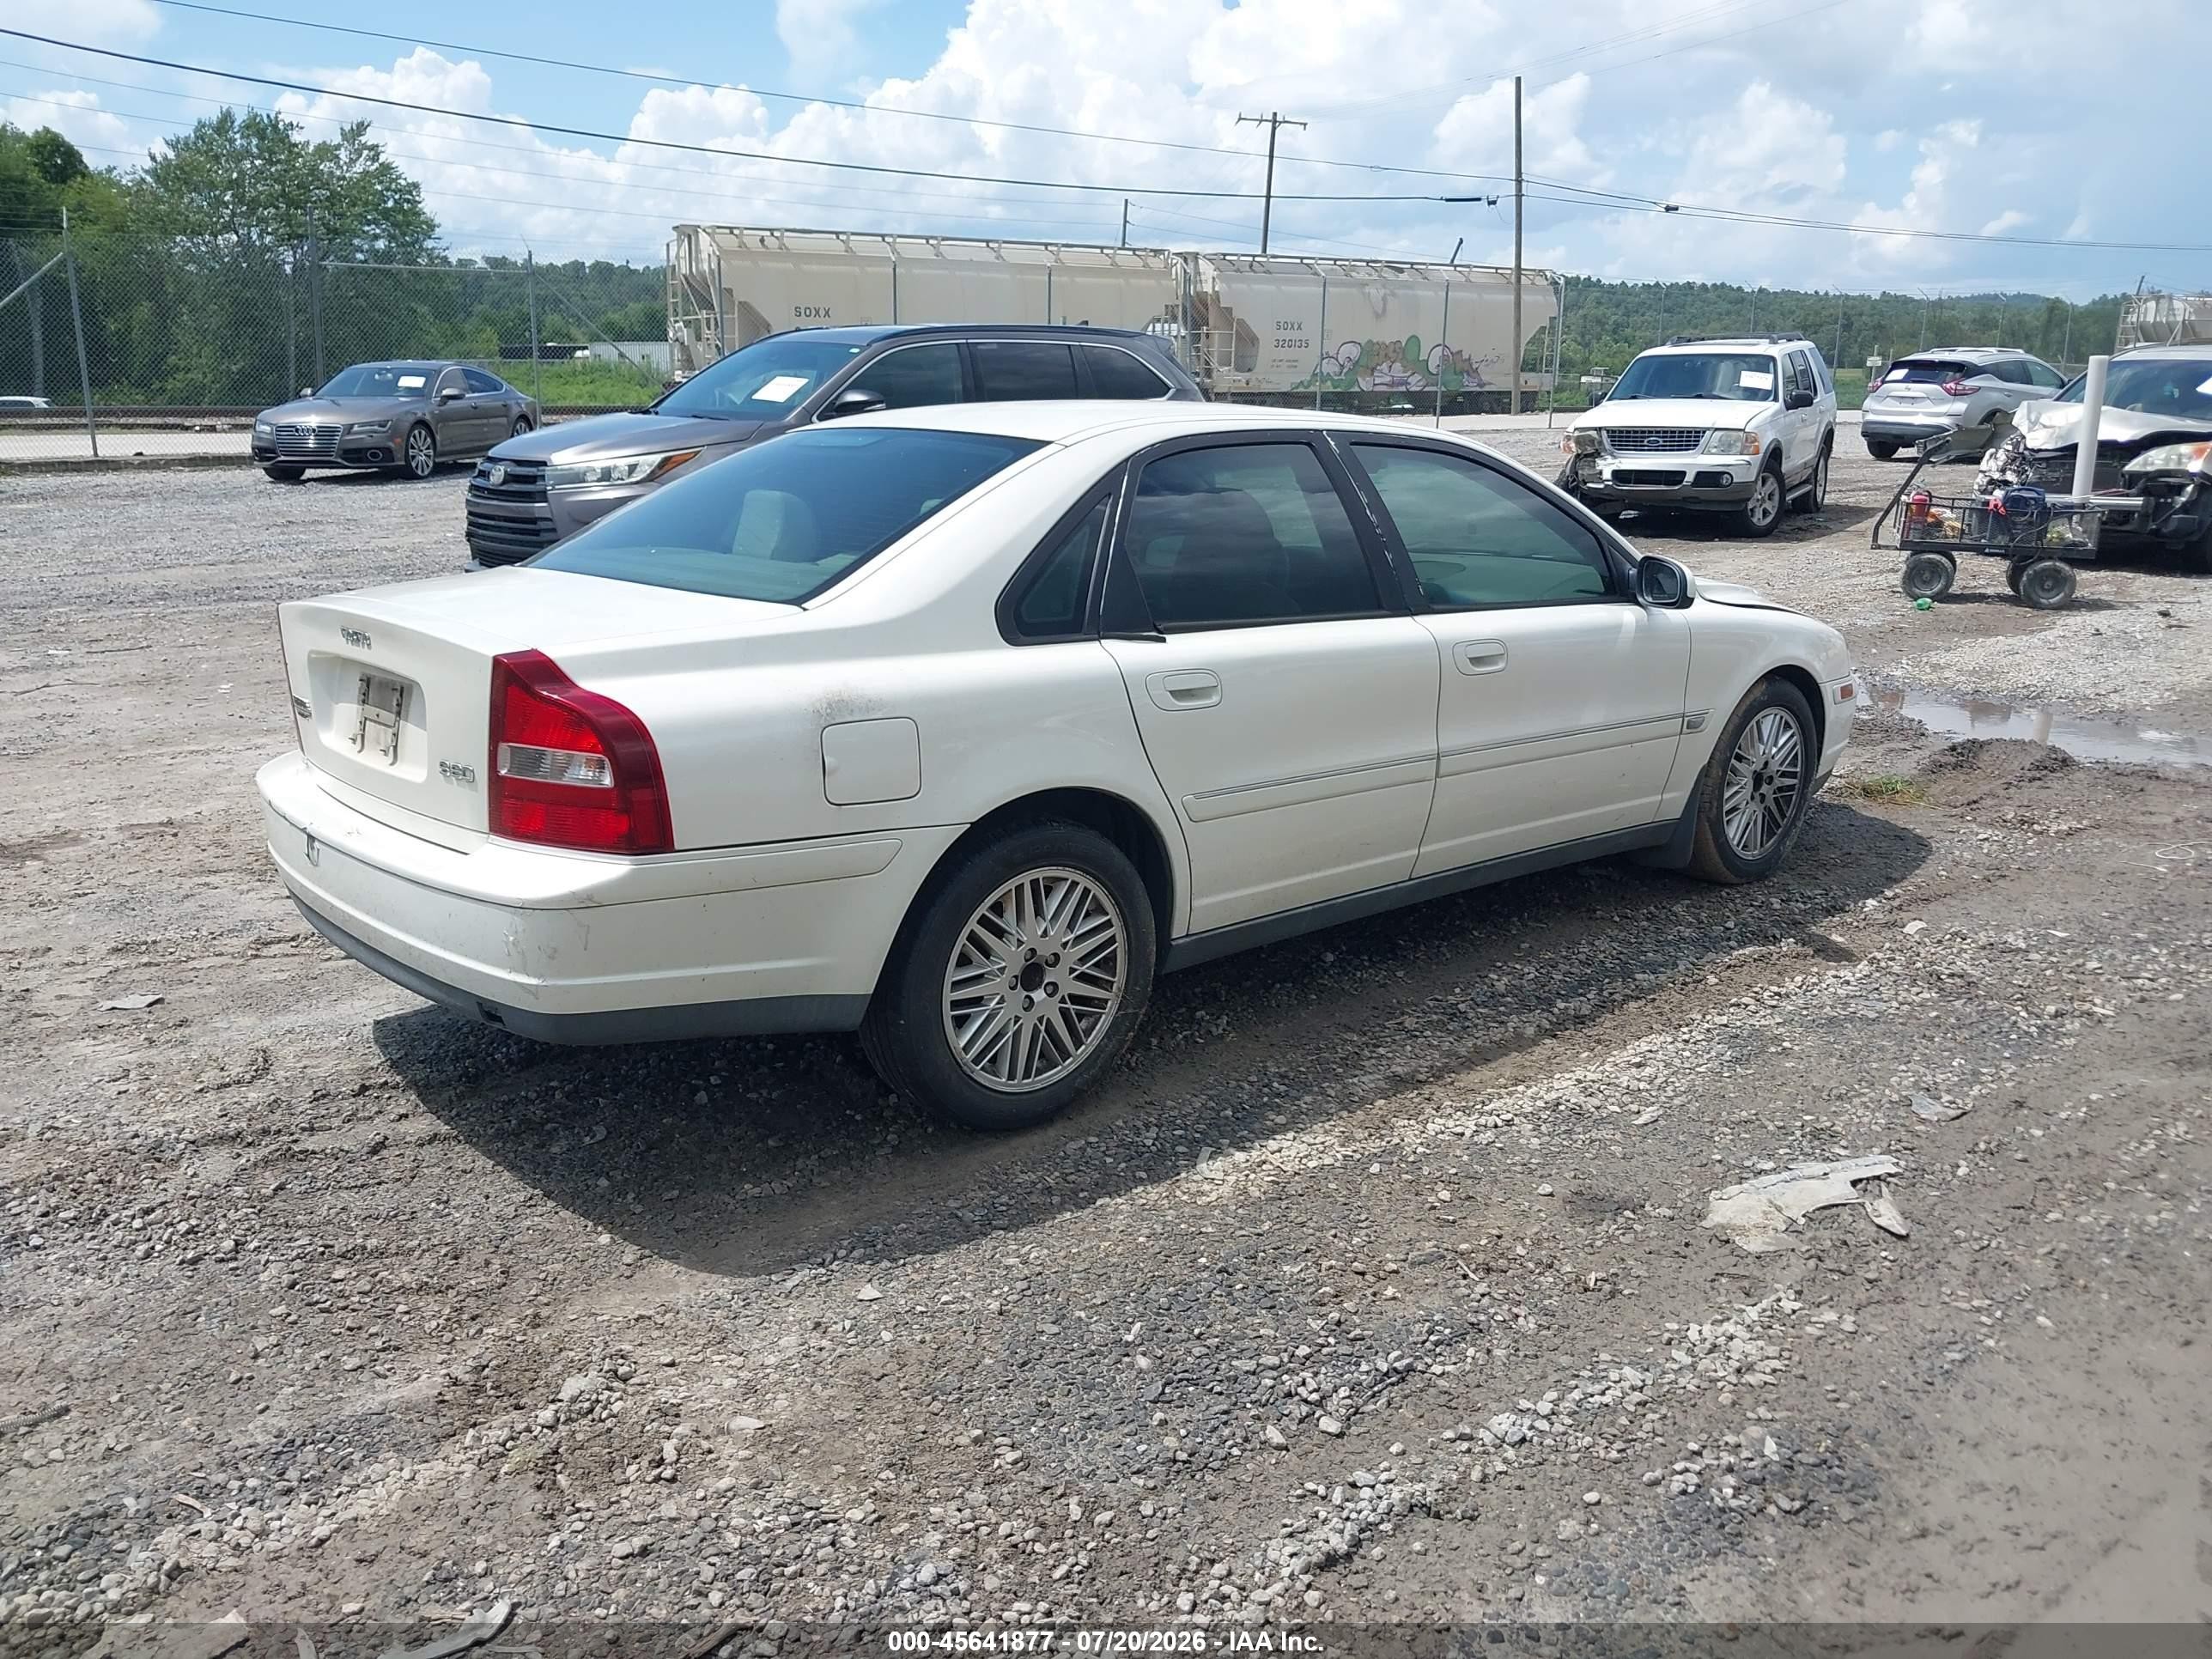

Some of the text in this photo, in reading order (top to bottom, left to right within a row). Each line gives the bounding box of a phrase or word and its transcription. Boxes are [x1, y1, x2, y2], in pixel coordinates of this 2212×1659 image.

[793, 306, 831, 319] SOXX
[1275, 320, 1304, 331] SOXX
[1273, 338, 1310, 349] 320135
